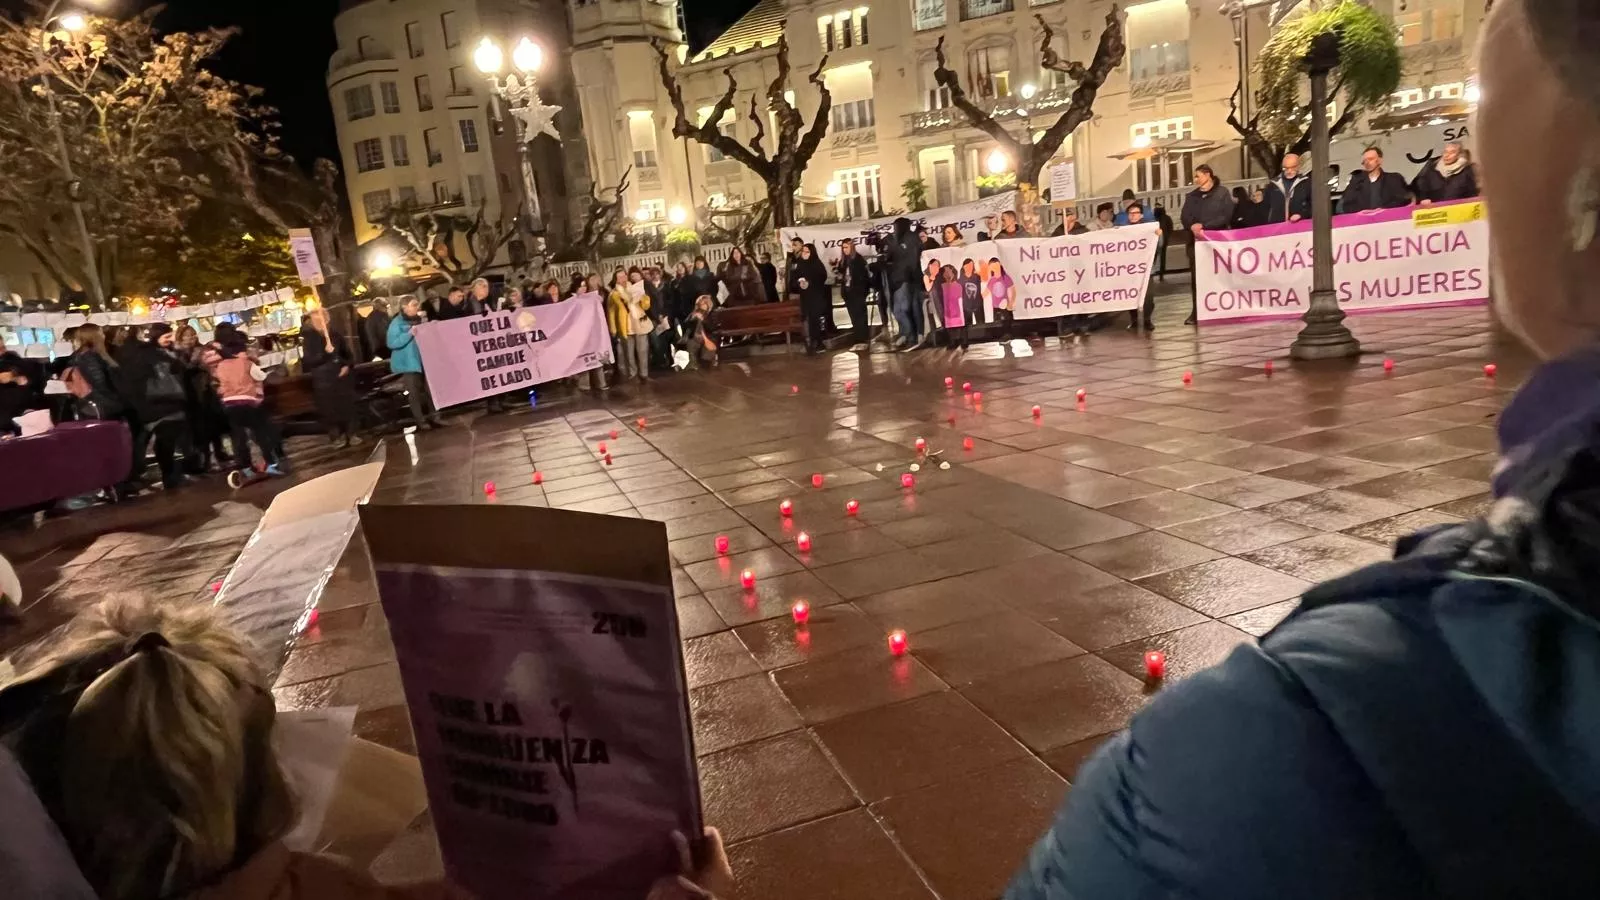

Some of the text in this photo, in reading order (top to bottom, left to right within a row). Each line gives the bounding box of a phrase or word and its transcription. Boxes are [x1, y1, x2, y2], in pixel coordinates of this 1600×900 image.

[1020, 238, 1147, 262] Ni una menos
[1213, 246, 1260, 275] NO
[1332, 230, 1471, 265] VIOLENCIA
[1022, 261, 1147, 285] vivas y libres
[1024, 287, 1139, 310] nos queremo
[1204, 287, 1301, 312] CONTRA
[1361, 268, 1483, 300] MUJERES
[469, 316, 511, 336] QUE LA
[477, 350, 526, 372] CAMBIE
[480, 368, 532, 391] DE LADO
[484, 700, 523, 725] LA
